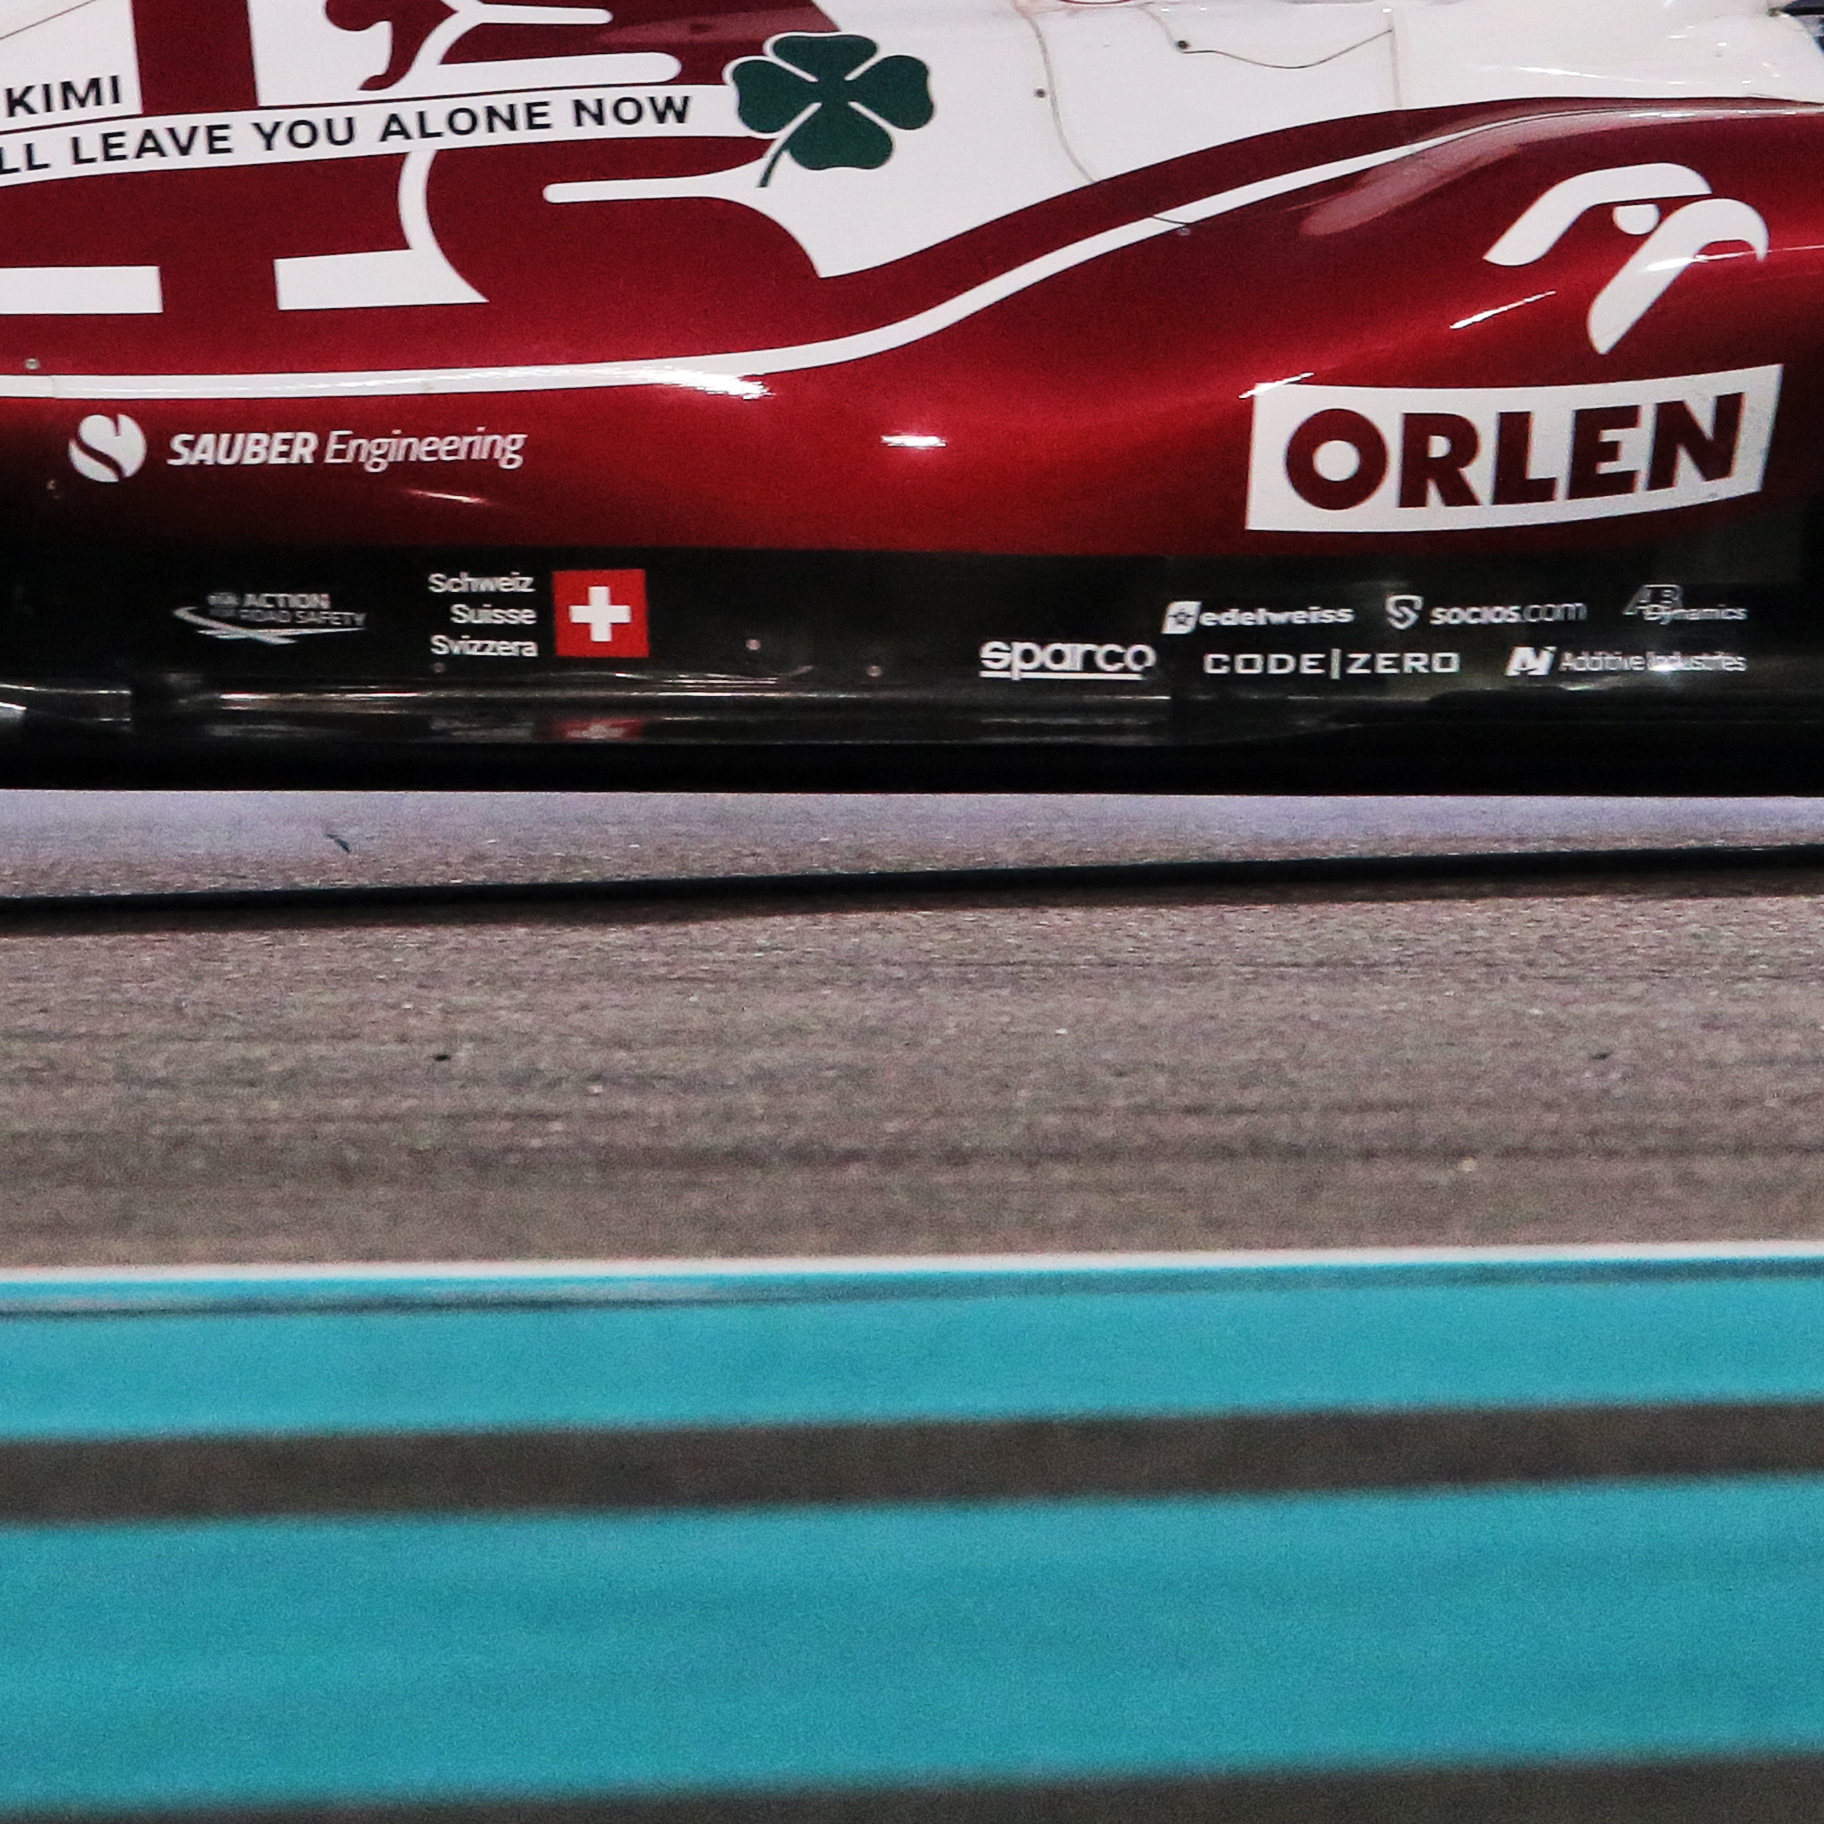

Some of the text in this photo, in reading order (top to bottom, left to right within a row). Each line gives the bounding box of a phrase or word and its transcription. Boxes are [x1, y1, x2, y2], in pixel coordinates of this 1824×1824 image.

[7, 75, 122, 117] KIMI
[71, 123, 233, 165] LEAVE
[251, 114, 357, 152] YOU
[379, 101, 553, 144] ALONE
[571, 95, 693, 127] NOW
[166, 425, 528, 473] SAUBER Engineering
[1286, 392, 1746, 511] ORLEN
[428, 572, 536, 594] Schweiz
[450, 603, 537, 625] Suisse
[1198, 605, 1355, 628] edelweiss
[1429, 601, 1587, 625] socios.com
[430, 634, 539, 658] Svizzera
[978, 640, 1158, 682] sparco
